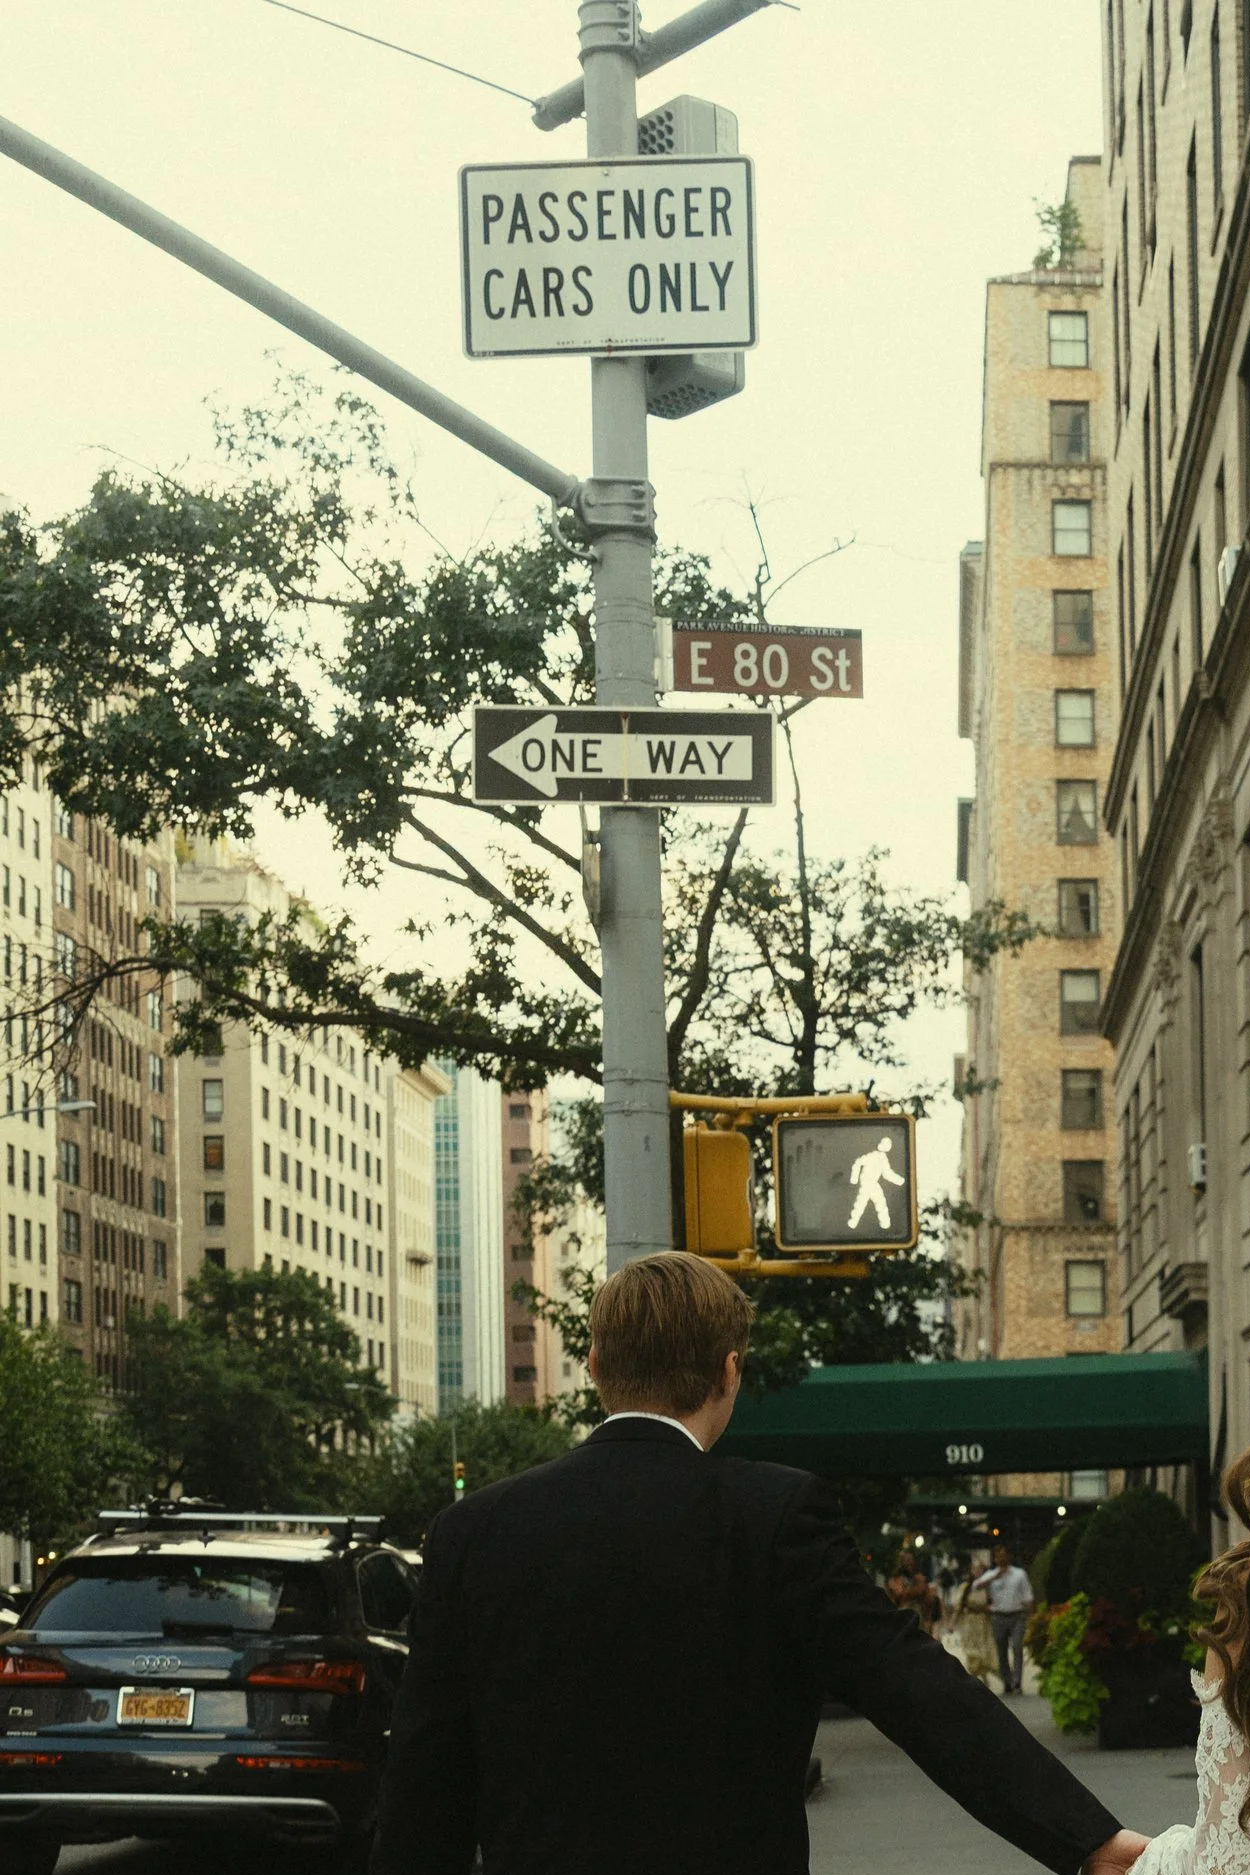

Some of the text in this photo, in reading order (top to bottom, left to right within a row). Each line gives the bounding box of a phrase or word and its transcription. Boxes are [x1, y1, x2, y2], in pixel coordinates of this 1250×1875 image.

[482, 186, 733, 245] PASSENGER
[482, 260, 734, 320] CARS ONLY
[677, 621, 704, 632] PARK
[707, 623, 750, 634] AVENUE
[690, 641, 852, 692] E 80 St
[521, 738, 734, 775] ONE WAY
[945, 1443, 984, 1465] 910
